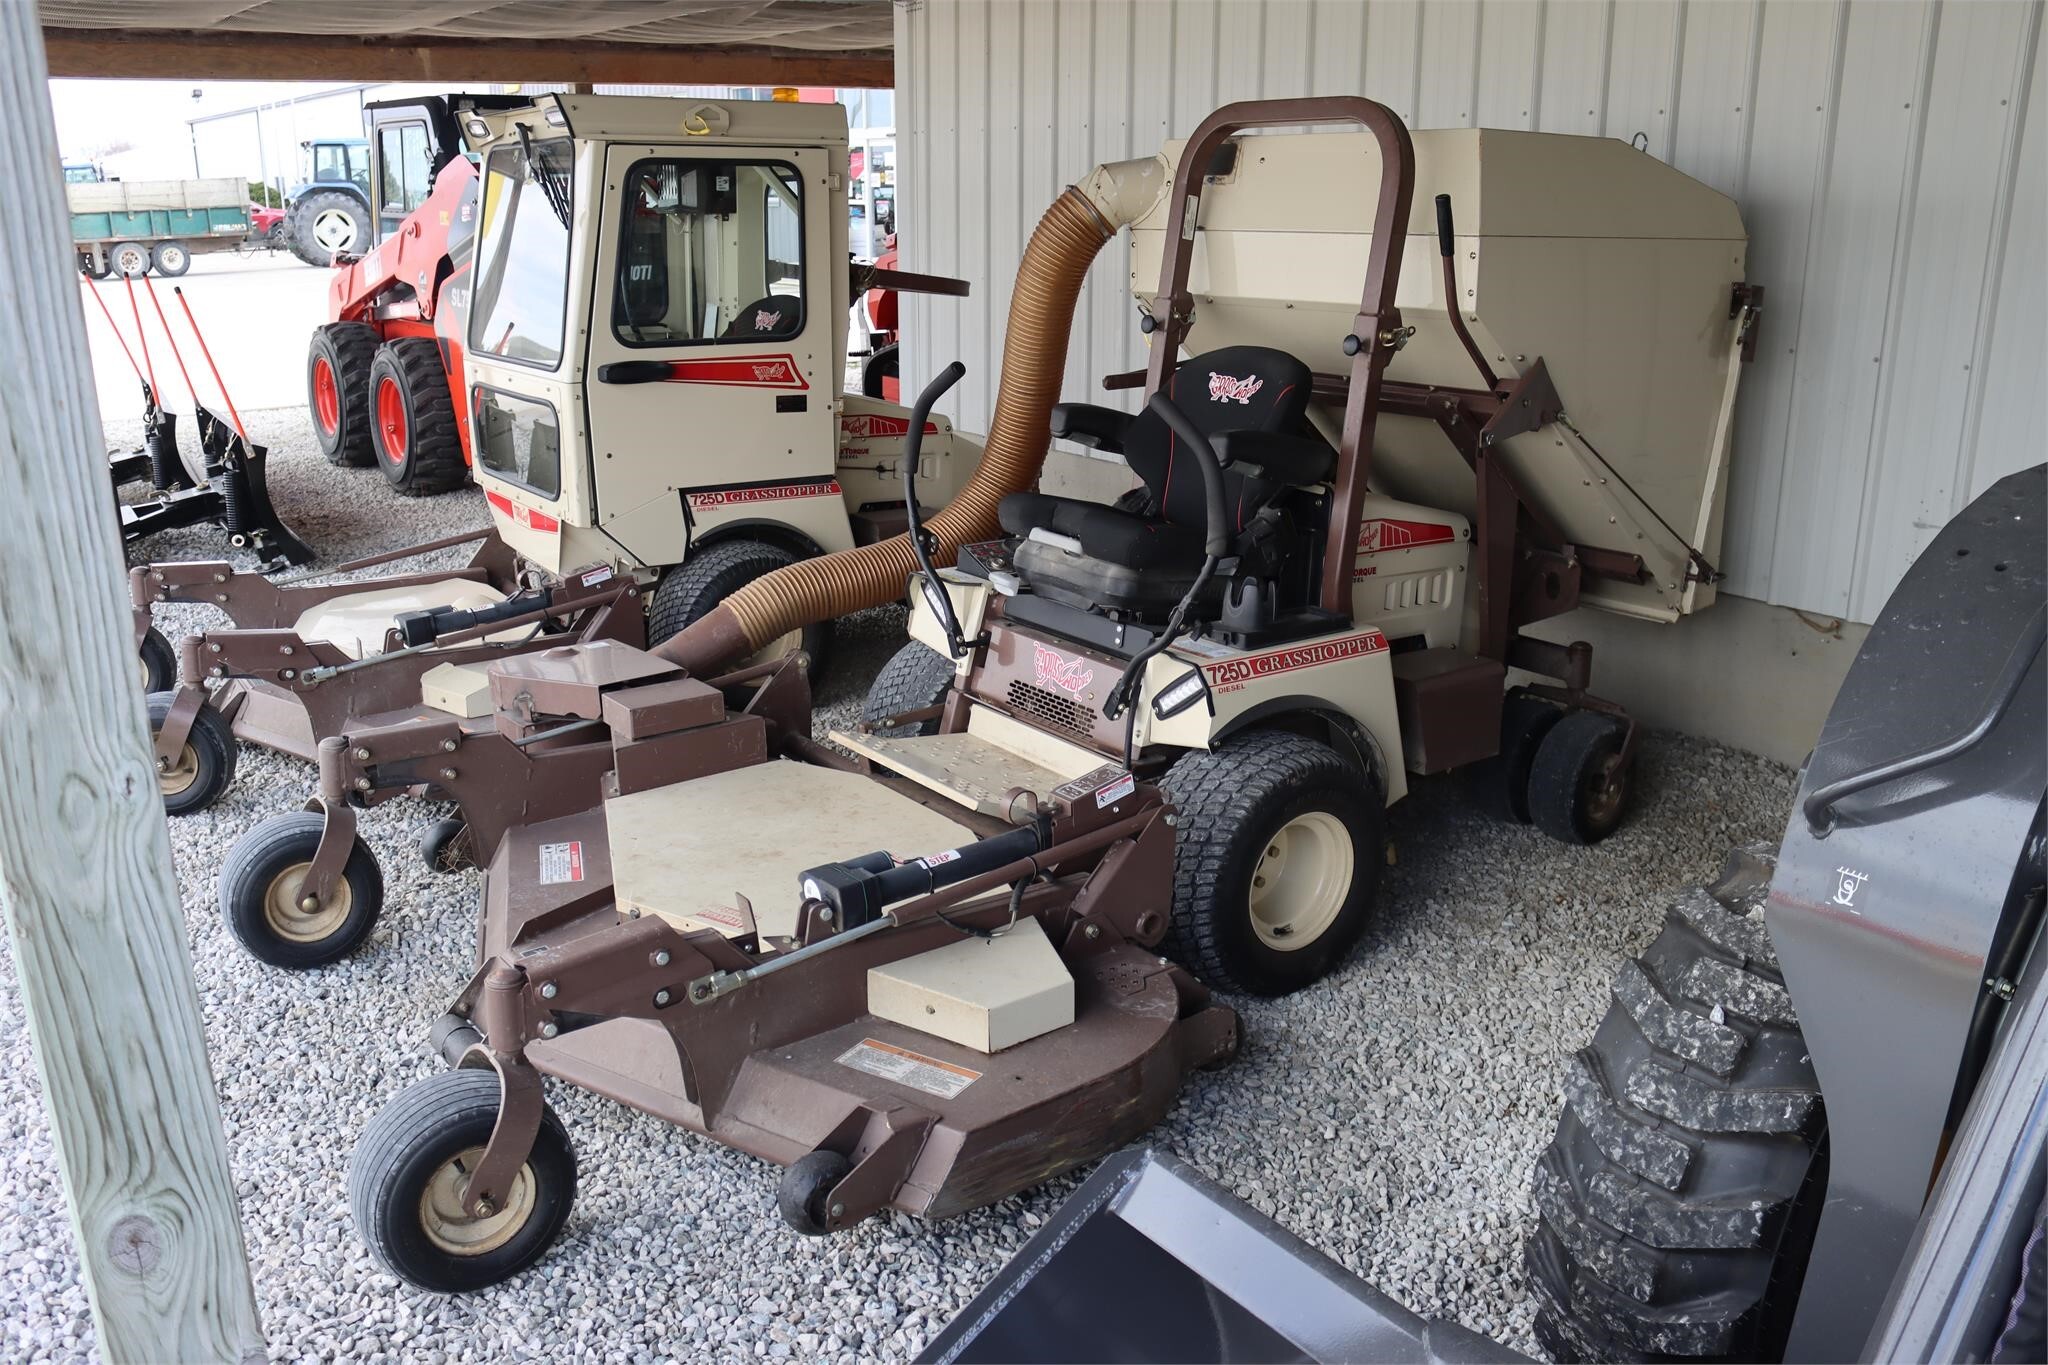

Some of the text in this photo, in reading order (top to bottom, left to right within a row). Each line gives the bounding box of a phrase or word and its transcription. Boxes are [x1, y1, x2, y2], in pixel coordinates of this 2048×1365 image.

[689, 484, 833, 506] 725D GRASSHOPPER
[1353, 566, 1377, 577] ORQUE
[1206, 660, 1251, 685] 725D
[1256, 636, 1378, 673] GRASSHOPPER
[1217, 684, 1246, 695] DIESEL
[928, 853, 950, 866] STEP
